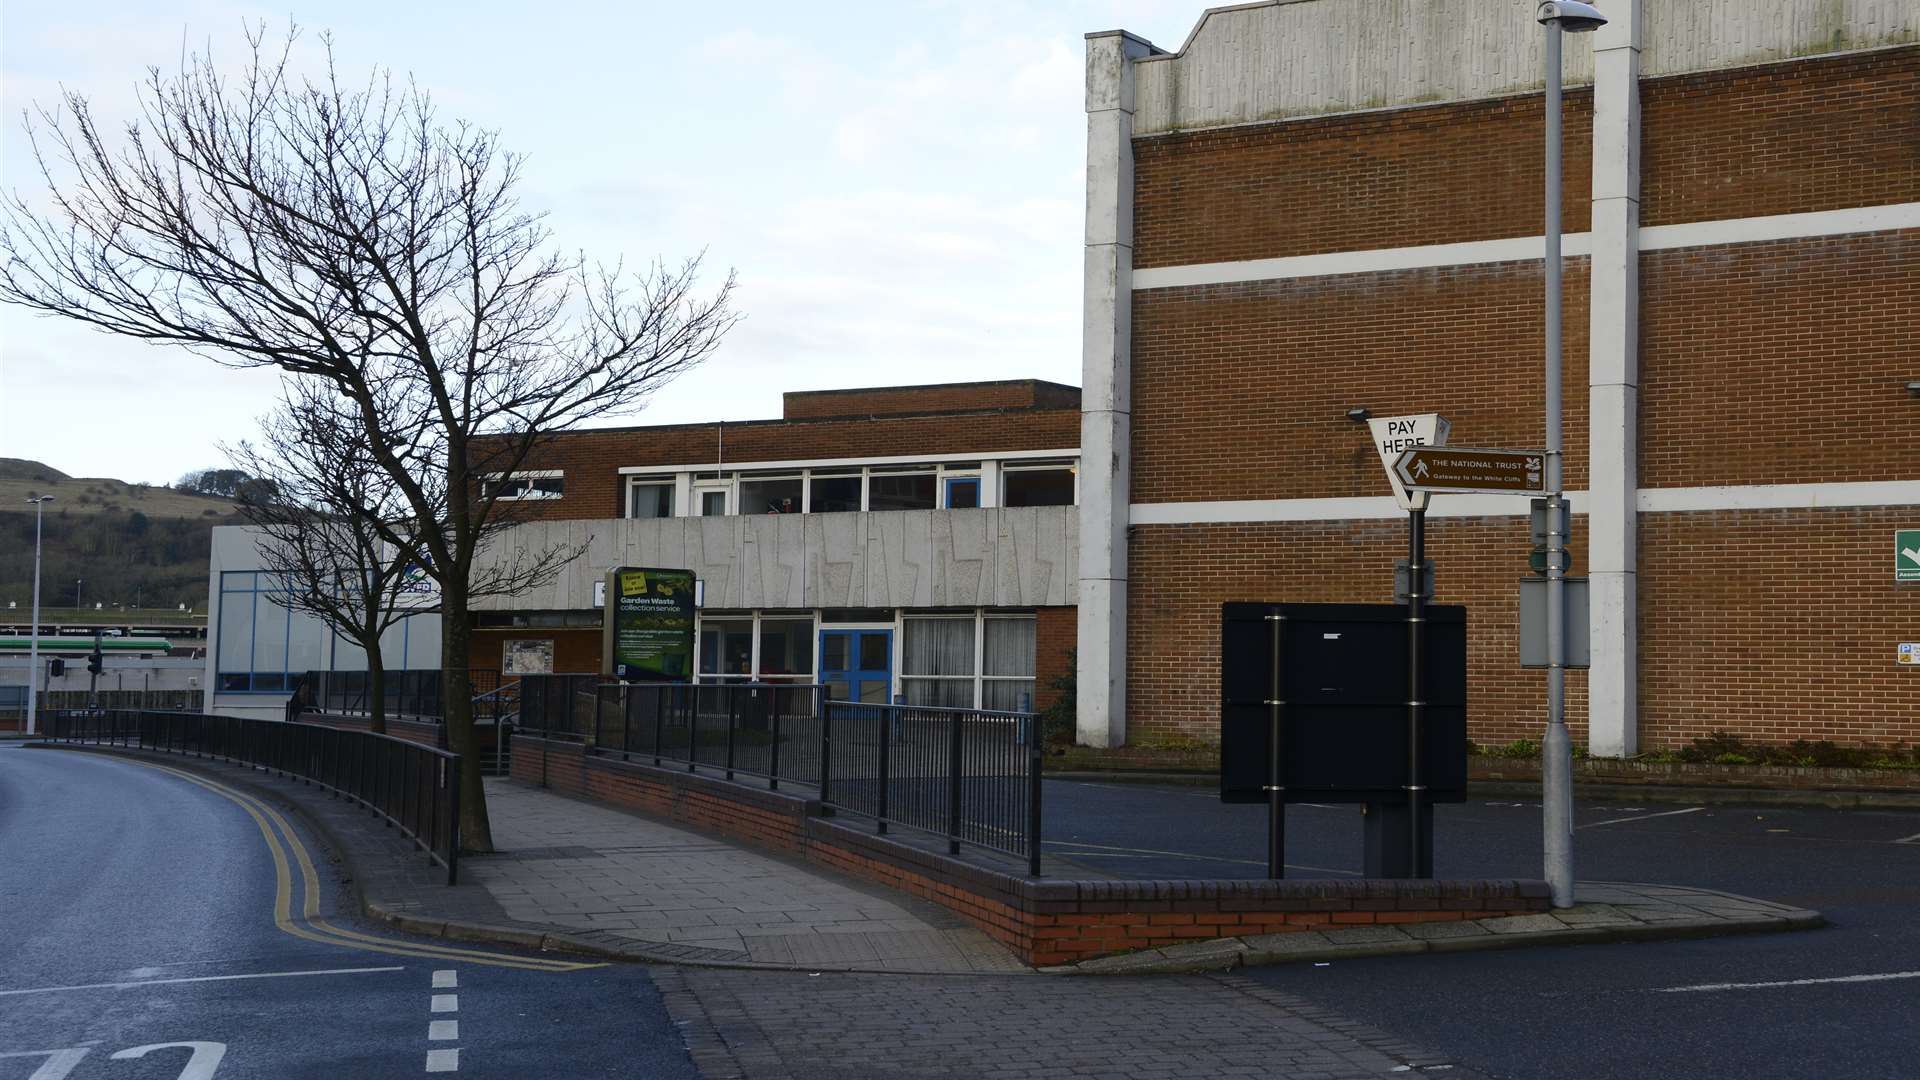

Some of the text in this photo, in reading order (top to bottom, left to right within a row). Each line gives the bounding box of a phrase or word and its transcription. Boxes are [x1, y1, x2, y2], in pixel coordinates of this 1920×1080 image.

[1388, 420, 1416, 435] PAY
[1432, 459, 1522, 470] THE NATIONAL TRUST
[1433, 473, 1460, 481] Gateway
[651, 597, 675, 605] Waste
[620, 604, 655, 612] collection
